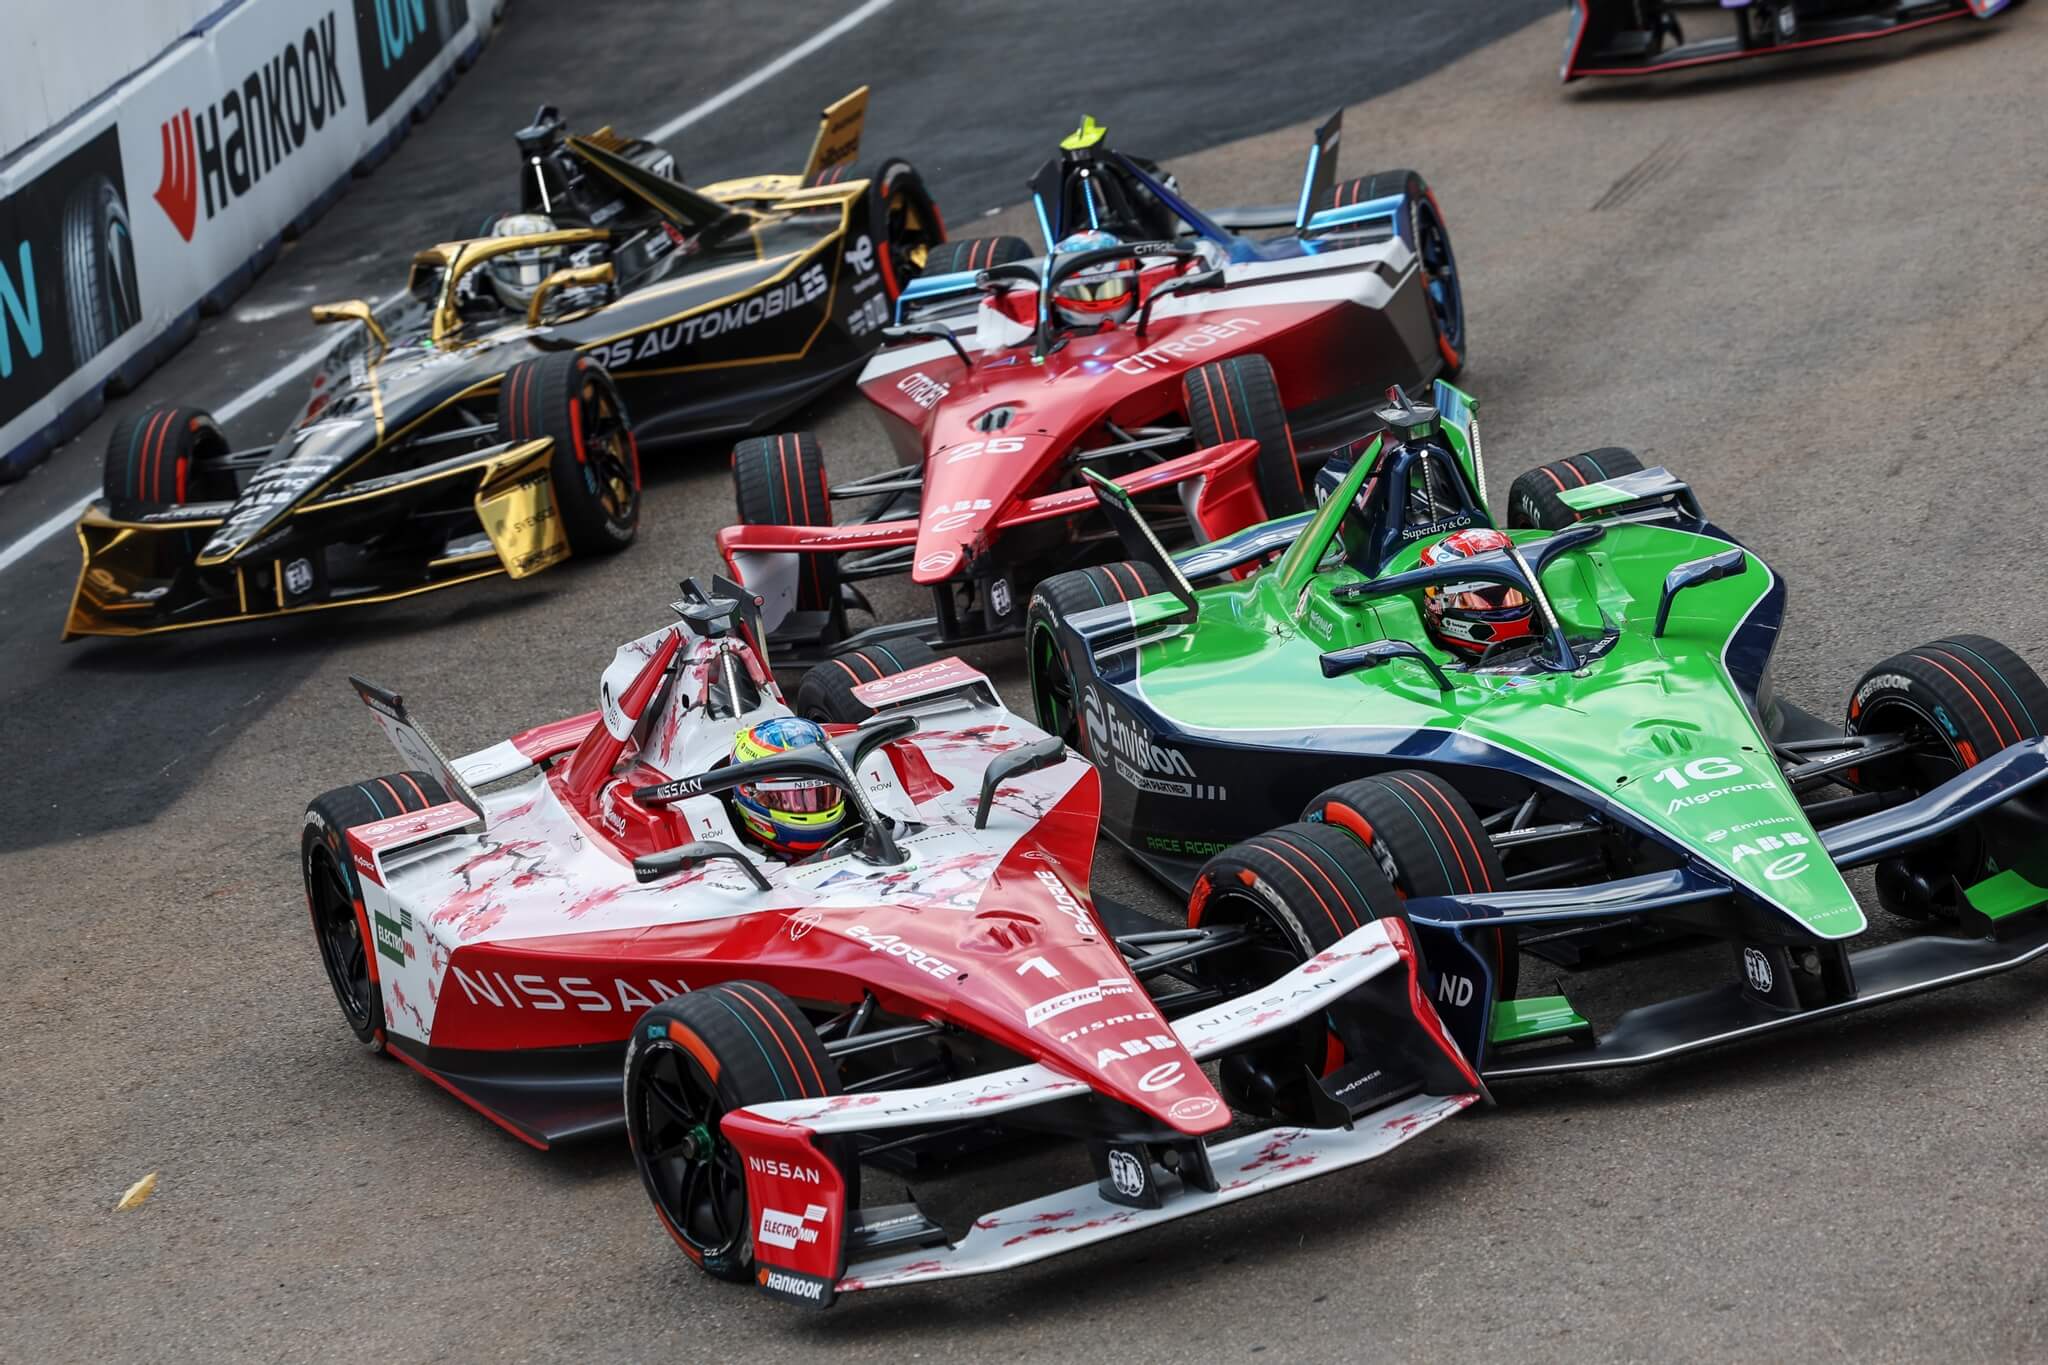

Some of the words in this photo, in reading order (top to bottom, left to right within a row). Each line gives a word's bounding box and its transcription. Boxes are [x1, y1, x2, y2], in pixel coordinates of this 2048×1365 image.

[635, 264, 829, 361] AUTOMOBILES
[944, 437, 1027, 465] 25
[926, 498, 993, 519] ABB
[1402, 522, 1447, 540] Superdry
[1456, 516, 1472, 529] Co
[1107, 702, 1198, 777] Envision
[870, 771, 881, 783] 1
[1653, 756, 1744, 791] 16
[656, 778, 703, 801] NISSAN
[1666, 780, 1778, 817] Algorand
[702, 818, 713, 830] 1
[1731, 815, 1797, 834] Envision
[1147, 837, 1181, 853] RACE
[1731, 831, 1811, 865] ABB
[1015, 956, 1062, 979] 1
[1196, 977, 1337, 1031] NISSAN
[1096, 1034, 1177, 1069] ABB
[749, 1155, 820, 1185] NISSAN
